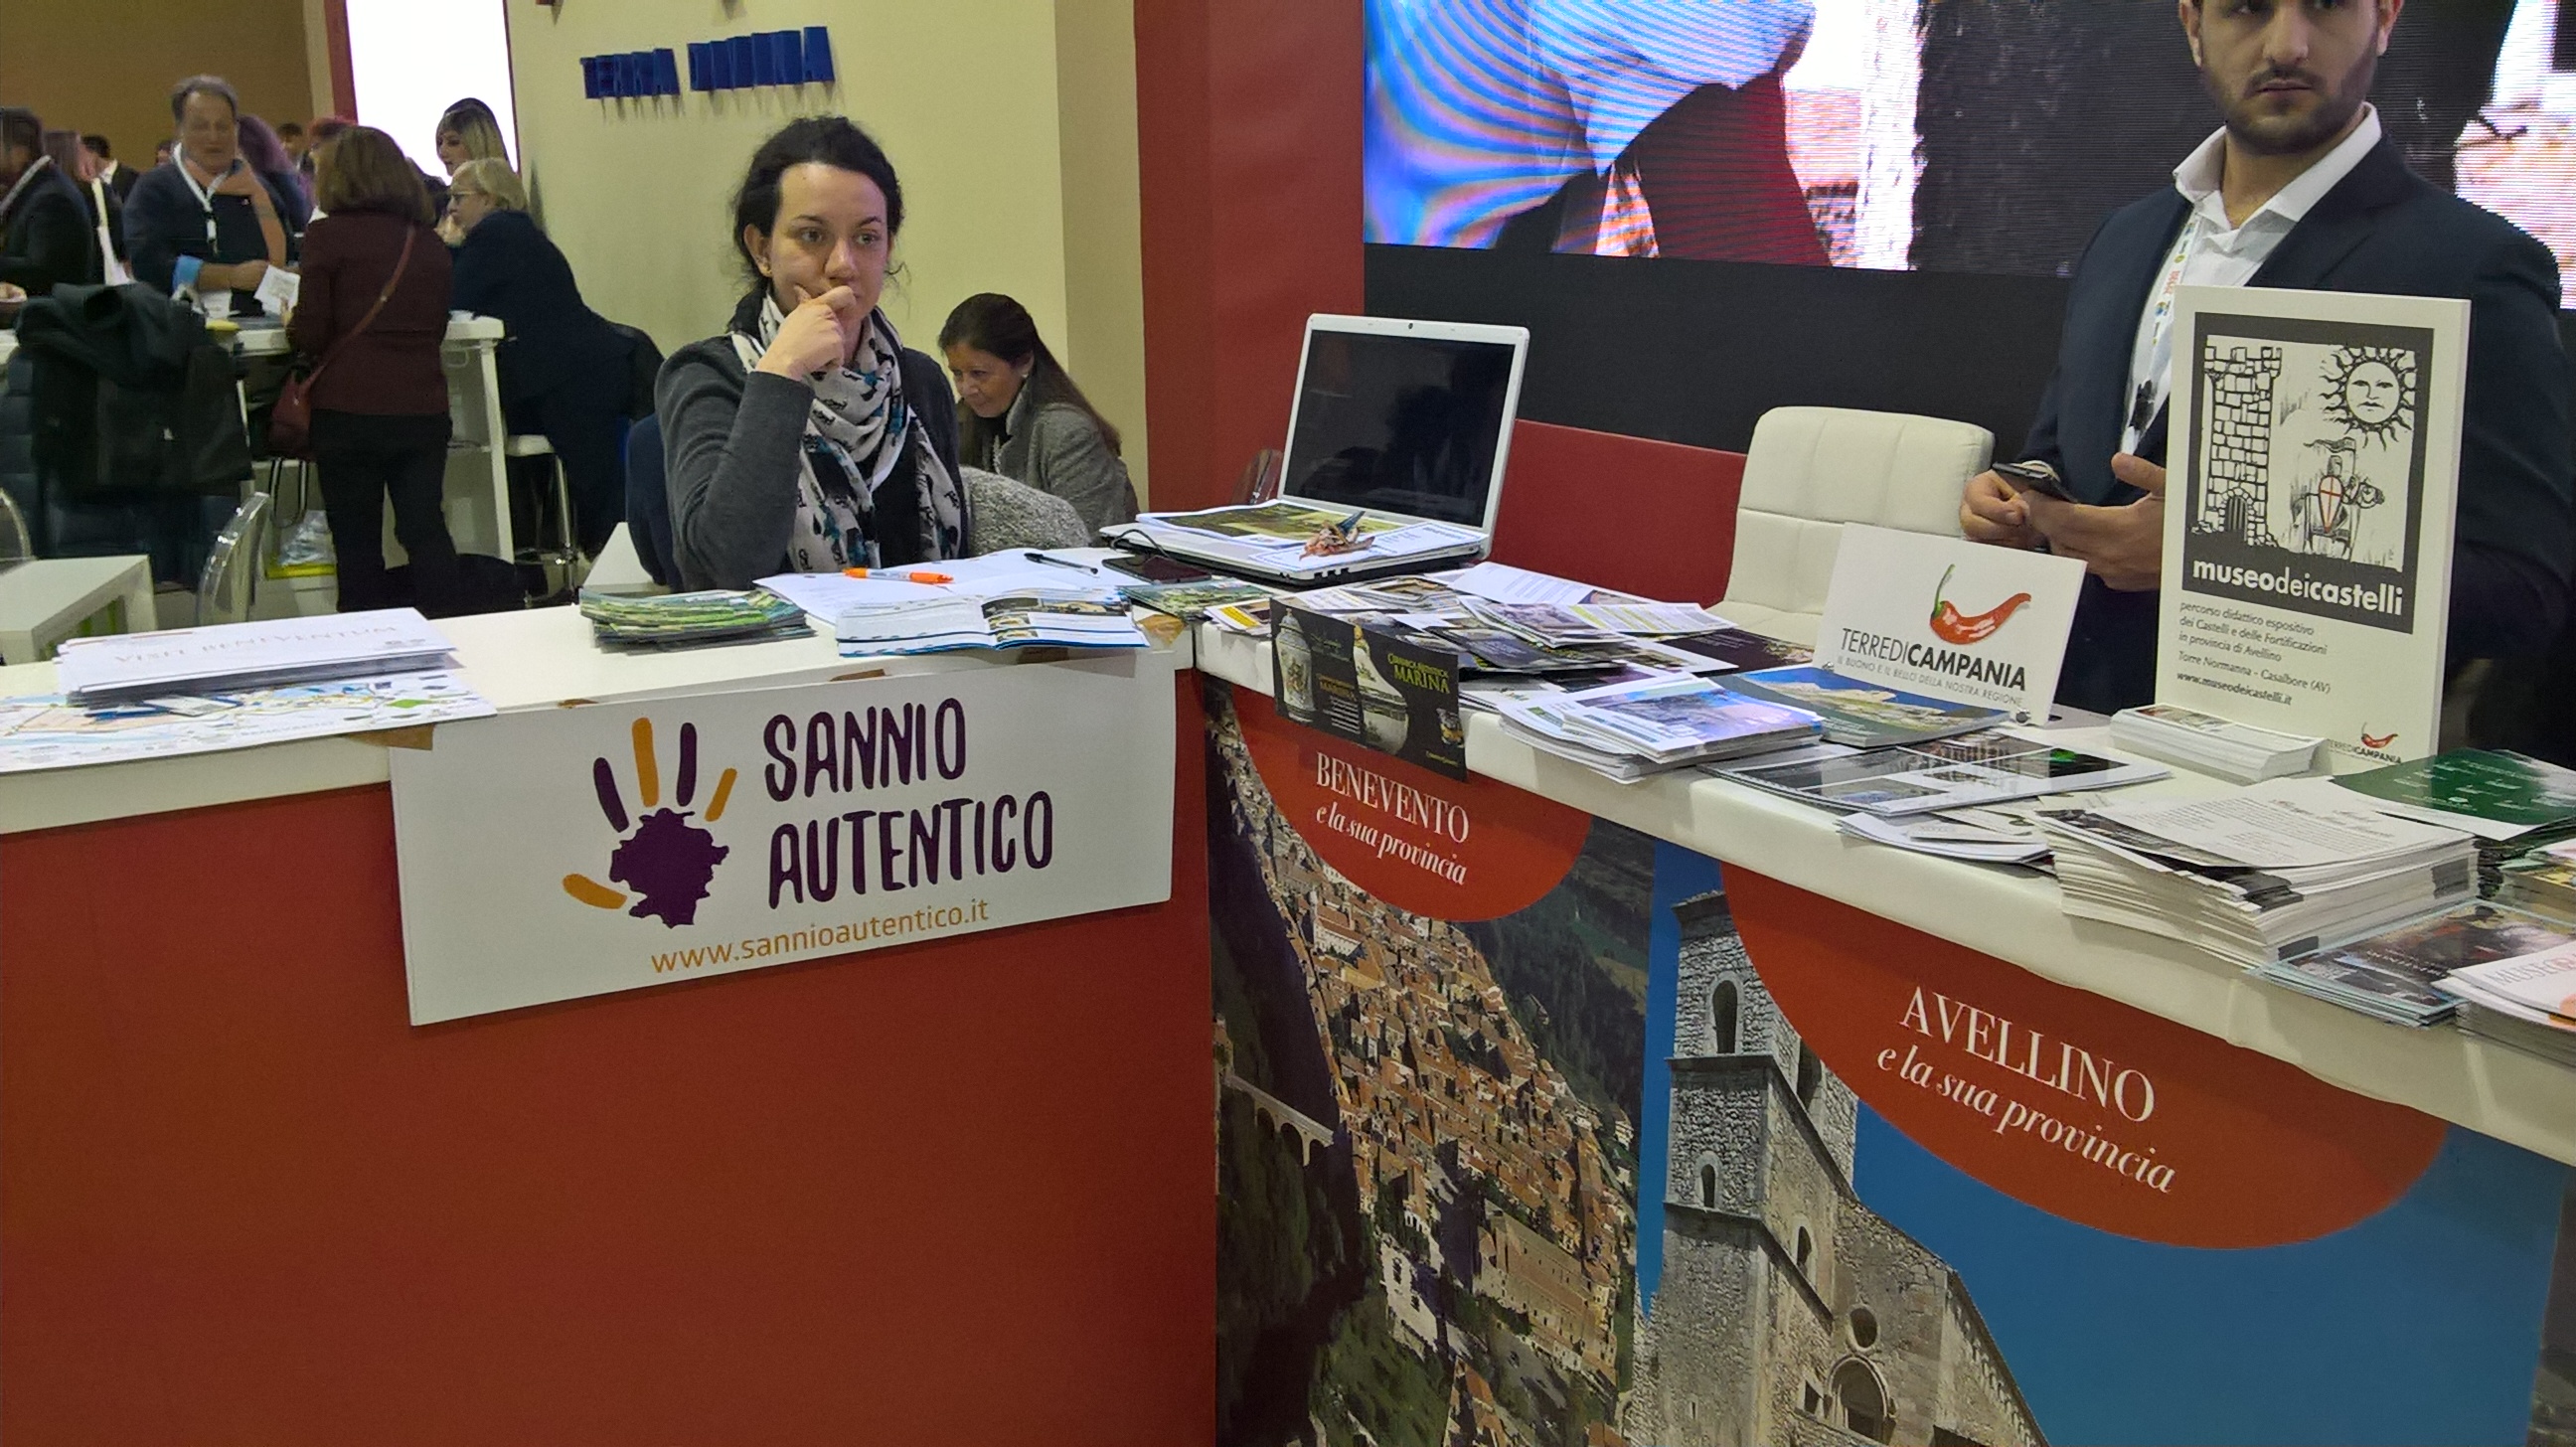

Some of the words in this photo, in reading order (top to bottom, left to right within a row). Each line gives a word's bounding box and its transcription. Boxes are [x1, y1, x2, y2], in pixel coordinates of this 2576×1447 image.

[2192, 560, 2404, 616] museodeicastelli
[2178, 631, 2188, 642] in
[2188, 634, 2232, 654] provincia
[2232, 641, 2244, 655] di
[2245, 645, 2283, 663] Avellino
[2179, 601, 2221, 619] percorso
[2222, 605, 2264, 627] didattico
[2265, 617, 2316, 637] espositivo
[2179, 615, 2194, 629] dei
[2194, 618, 2230, 636] Castelli
[2239, 627, 2263, 644] delle
[2264, 633, 2329, 656] Fortificazioni
[1393, 664, 1451, 695] MARINA
[1841, 627, 2026, 692] TERREDICAMPANIA
[1846, 657, 1876, 674] BUONO
[1893, 668, 1917, 683] BELLO
[1919, 674, 1943, 689] DELLA
[1945, 680, 1980, 697] NOSTRA
[1982, 688, 2023, 708] REGIONE
[2176, 671, 2293, 707] www.museodeicastelli.it
[2178, 650, 2203, 666] Torre
[2203, 657, 2252, 677] Normanna
[2260, 669, 2309, 690] Casalbore
[2310, 681, 2332, 695] (AV)
[763, 698, 967, 802] SANNIO
[1316, 751, 1470, 845] BENEVENTO
[767, 789, 1054, 910] AUTENTICO
[1316, 805, 1327, 824] e
[1328, 801, 1345, 833] la
[1347, 819, 1376, 848] sua
[1377, 832, 1468, 886] provincia
[651, 896, 990, 974] www.sannioautentico.it
[1898, 986, 2156, 1123] AVELLINO
[1877, 1046, 1897, 1071] e
[1899, 1044, 1935, 1089] la
[1936, 1071, 1996, 1117] sua
[1995, 1098, 2176, 1194] provincia
